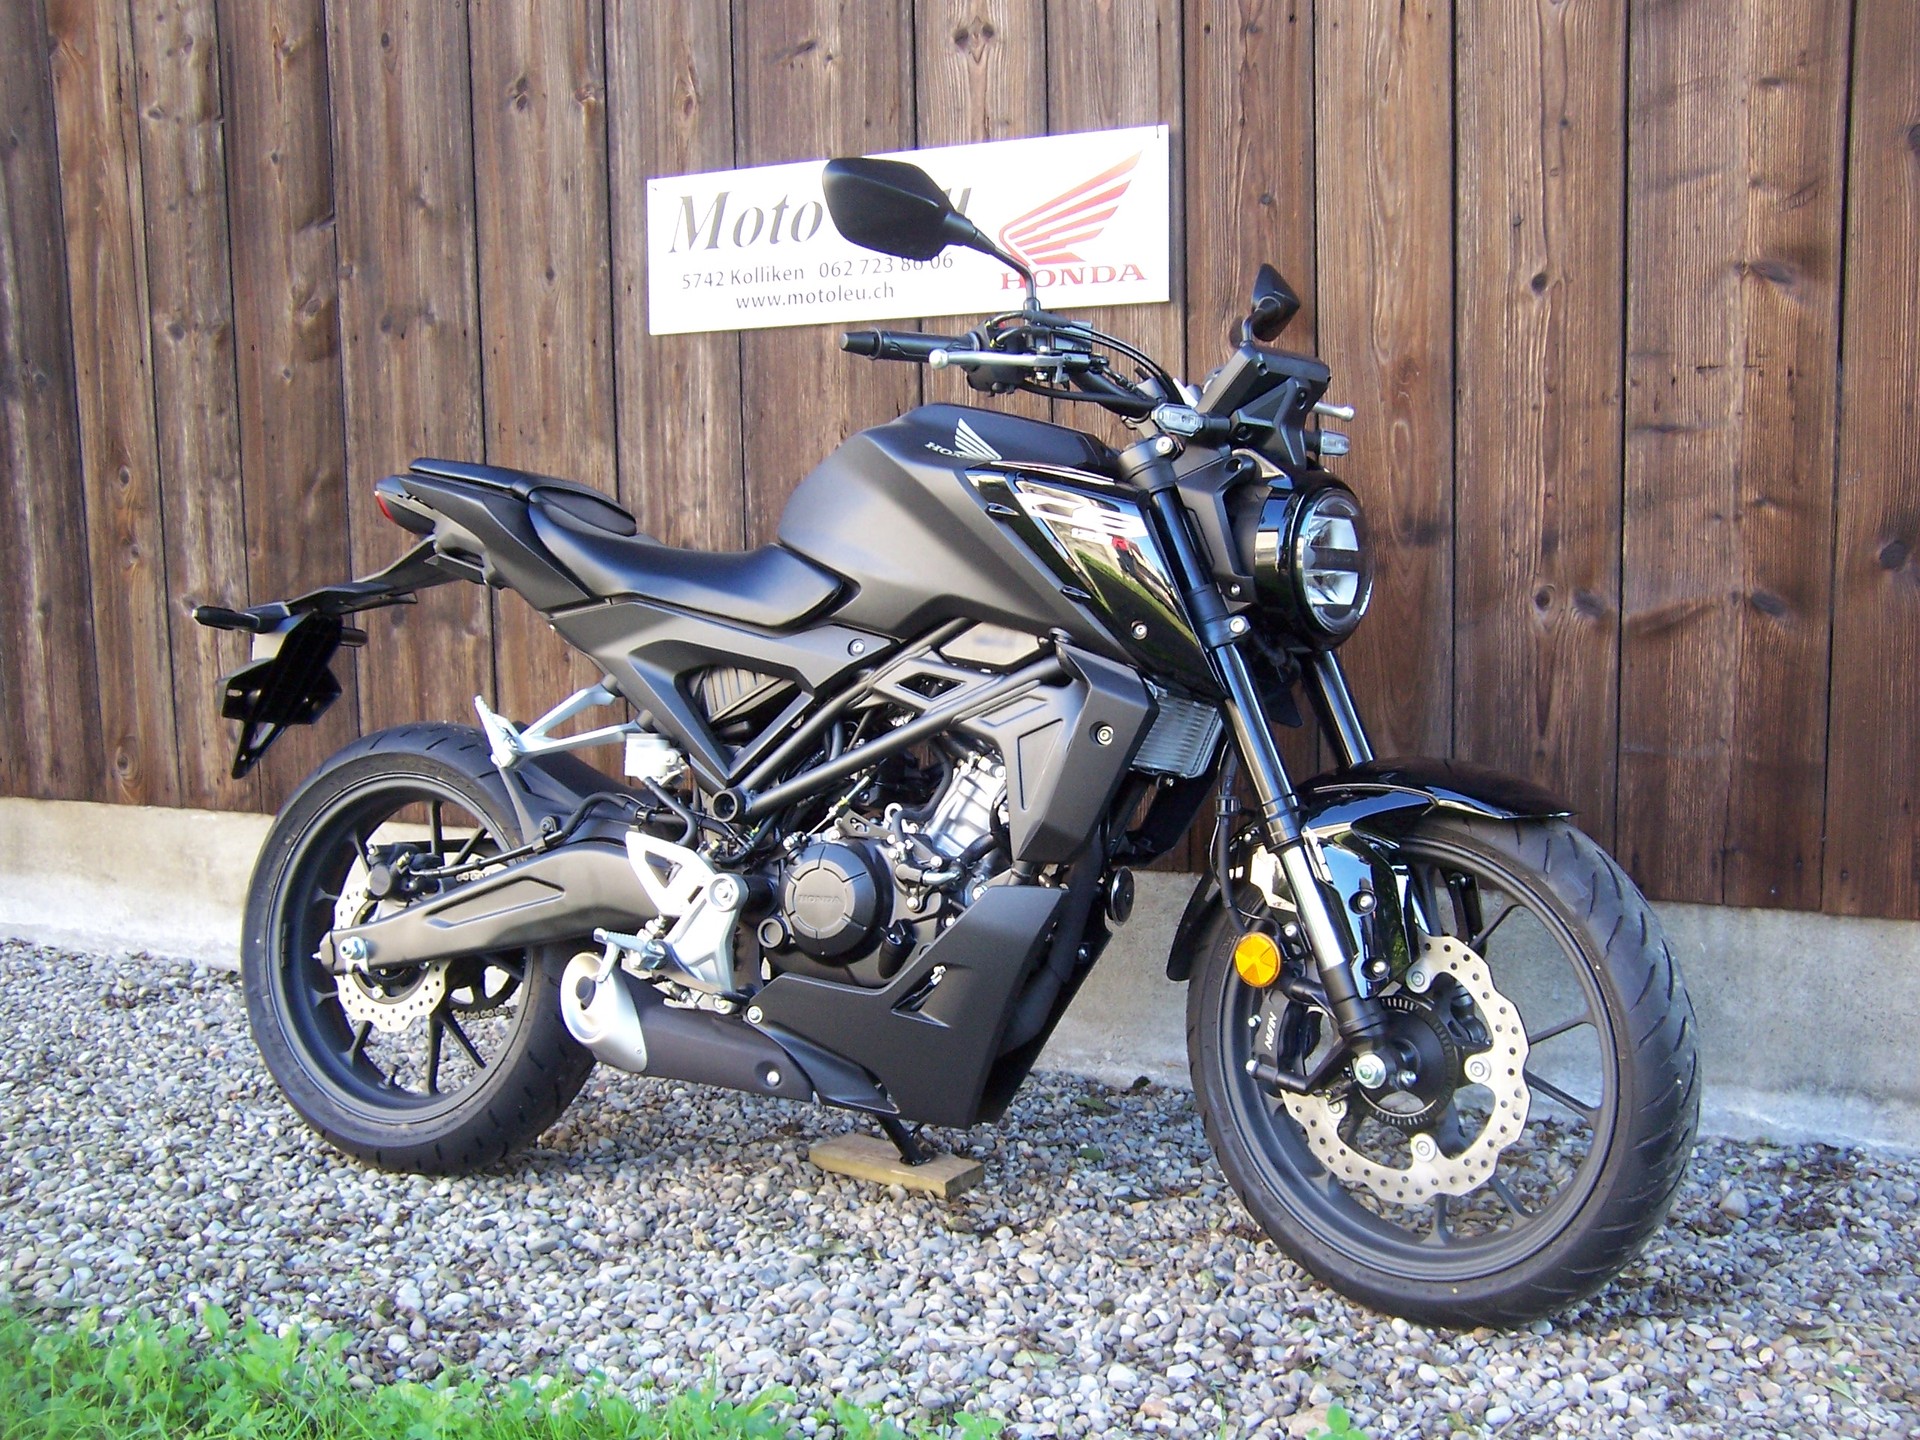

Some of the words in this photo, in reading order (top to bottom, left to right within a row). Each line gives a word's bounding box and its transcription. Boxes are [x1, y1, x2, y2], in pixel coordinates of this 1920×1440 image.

[682, 271, 724, 290] 5742
[819, 260, 853, 278] 062
[860, 257, 893, 275] 723
[930, 252, 953, 269] 06
[1001, 263, 1147, 290] HONDA
[736, 281, 894, 308] www.motoleu.ch
[798, 894, 843, 904] HONDA
